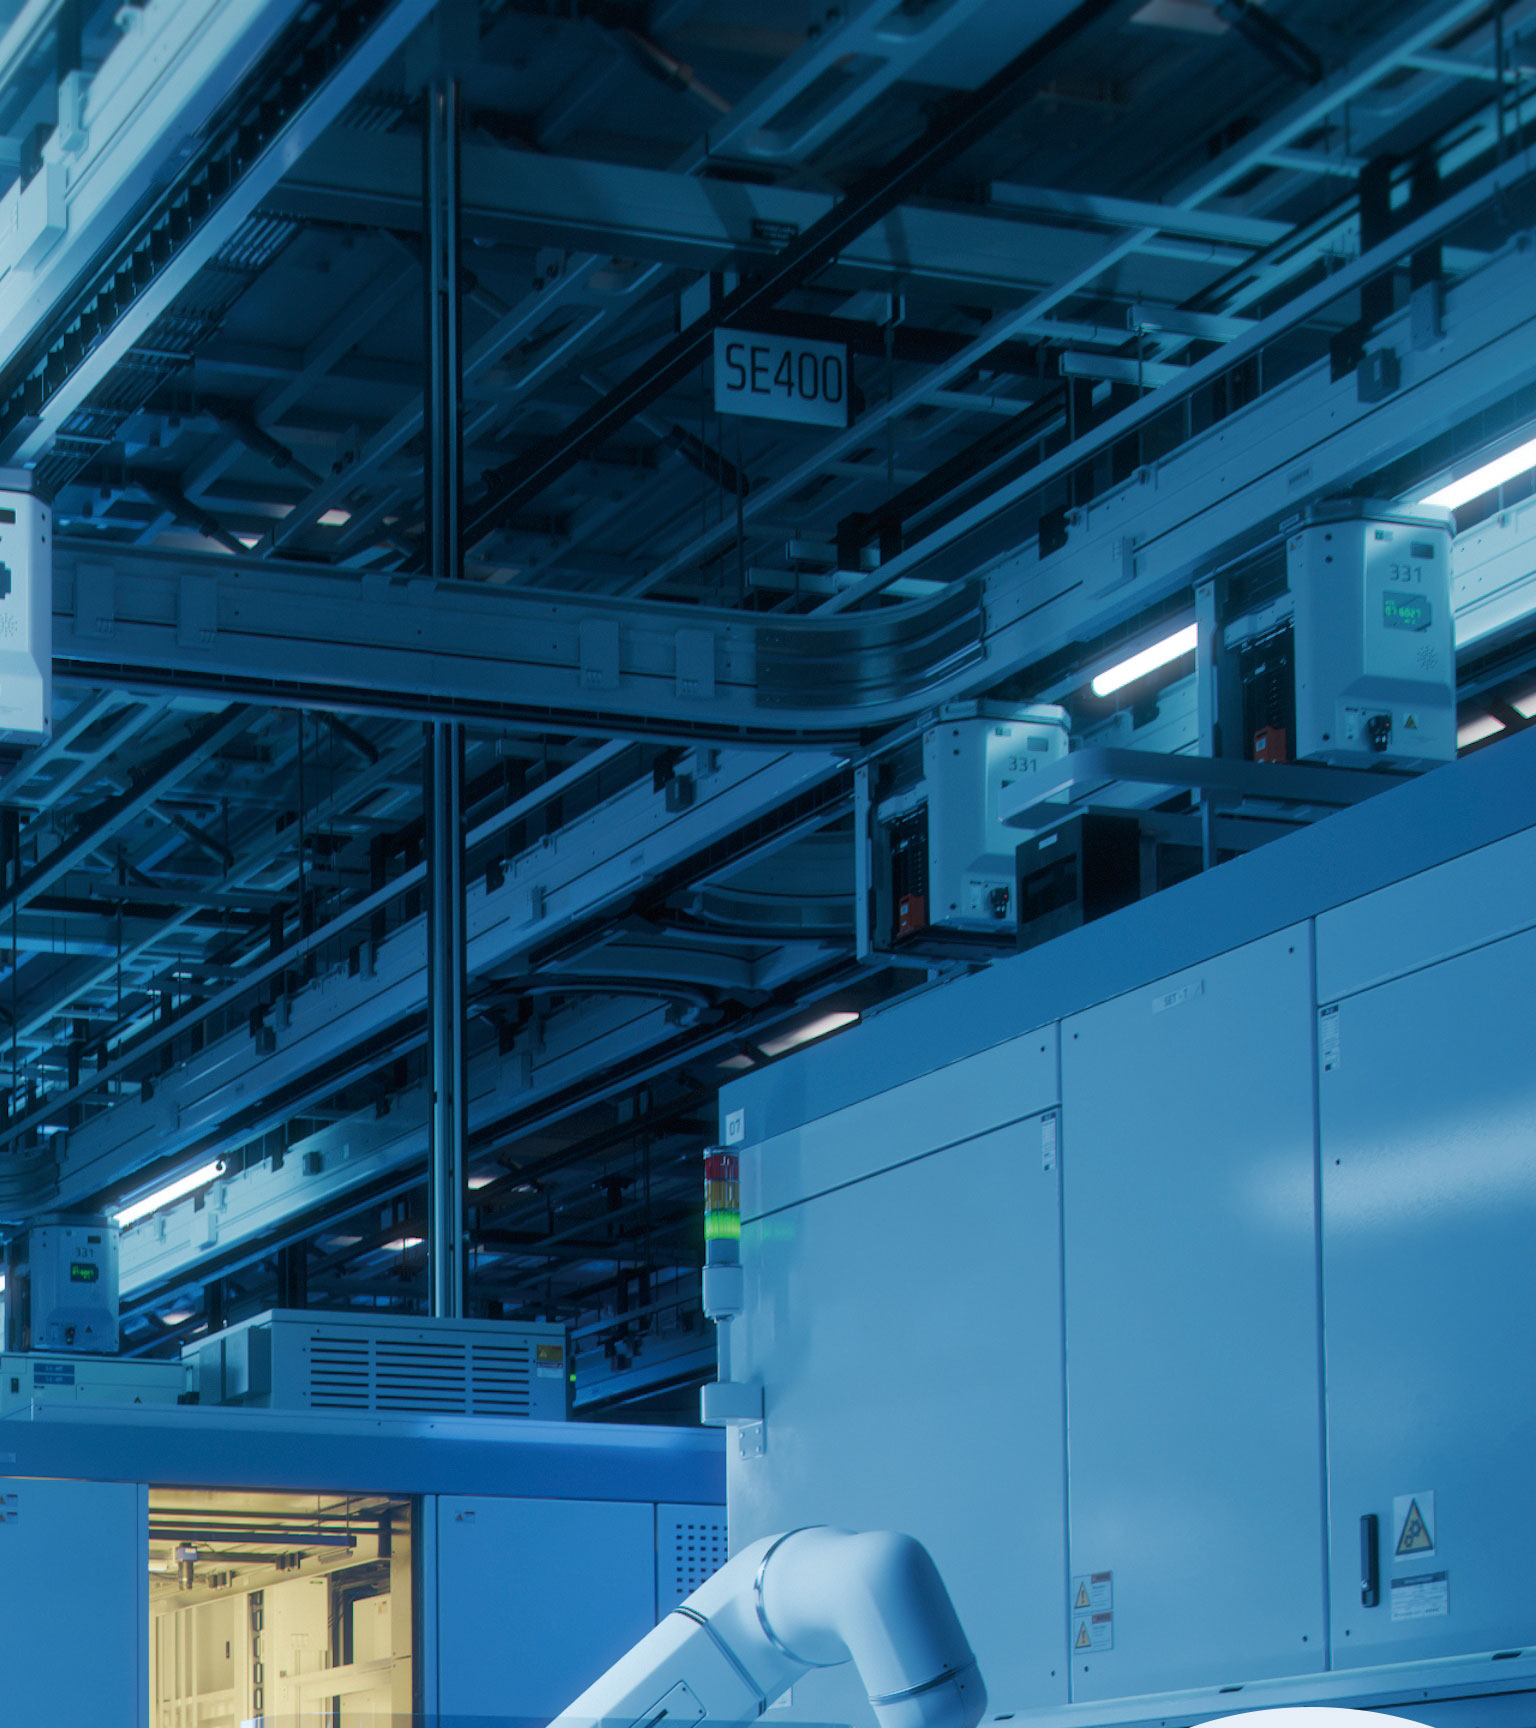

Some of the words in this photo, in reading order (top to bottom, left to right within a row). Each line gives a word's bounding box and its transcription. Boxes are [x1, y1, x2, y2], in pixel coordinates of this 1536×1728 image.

[726, 344, 842, 402] SE400
[1390, 563, 1422, 584] 331
[1008, 755, 1038, 773] 331
[729, 1118, 741, 1136] 07
